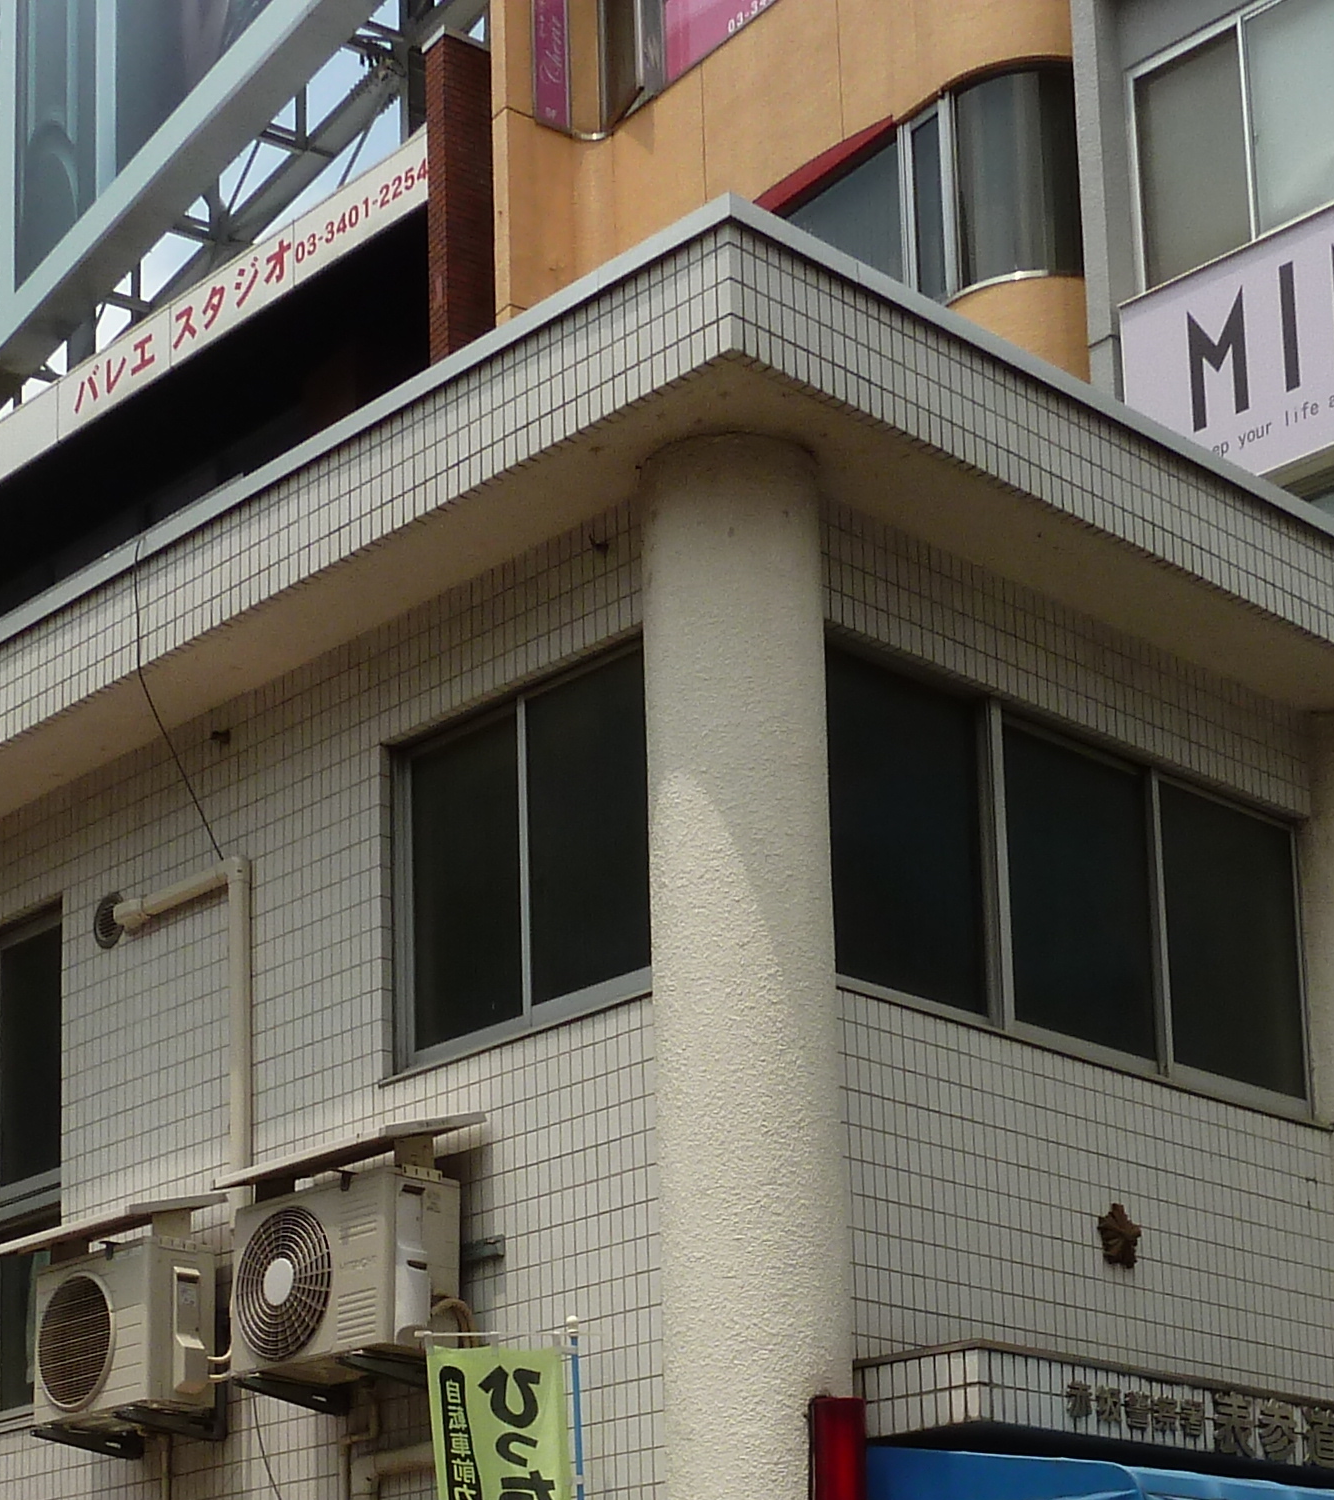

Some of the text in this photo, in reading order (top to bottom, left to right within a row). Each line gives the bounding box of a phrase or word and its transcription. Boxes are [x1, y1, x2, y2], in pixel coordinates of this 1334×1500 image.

[73, 158, 429, 414] バレエ スタジオ 03-3401-2254
[1237, 422, 1272, 450] your
[1284, 401, 1320, 428] life
